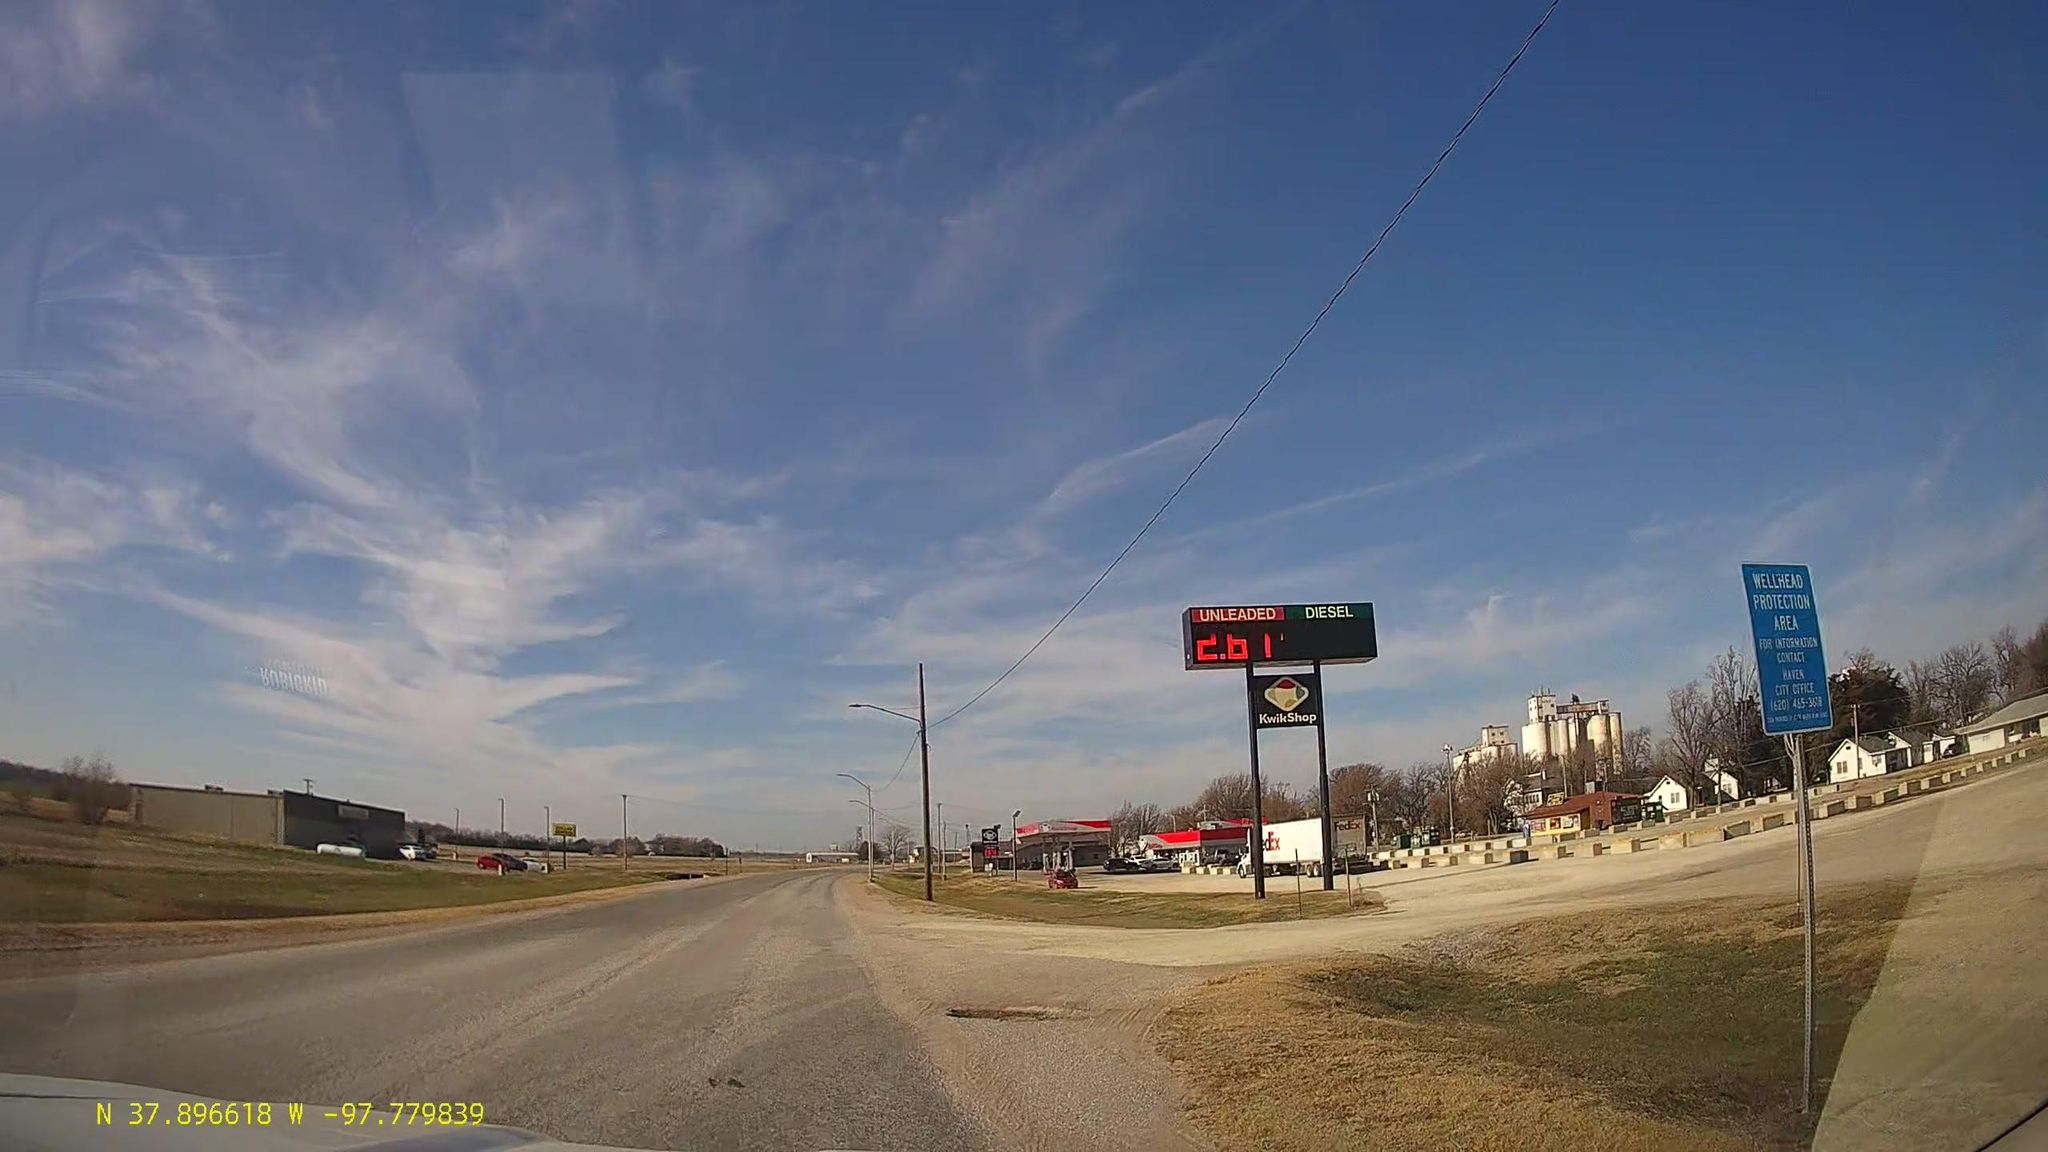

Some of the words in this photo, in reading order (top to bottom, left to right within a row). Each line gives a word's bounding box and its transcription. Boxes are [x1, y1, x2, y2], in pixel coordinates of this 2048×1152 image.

[1752, 573, 1804, 589] WELLHEAD
[1753, 594, 1811, 610] PROTECTION
[1200, 607, 1276, 621] UNLEADED
[1305, 605, 1354, 619] DIESEL
[1774, 615, 1799, 631] AREA
[1760, 639, 1773, 650] FOR
[1775, 637, 1818, 649] INFORMATION
[1776, 651, 1805, 663] CONTACT
[1782, 669, 1805, 680] HAVEN
[1775, 684, 1790, 696] CITY
[1792, 682, 1815, 695] OFFICE
[1334, 820, 1360, 831] FedEx
